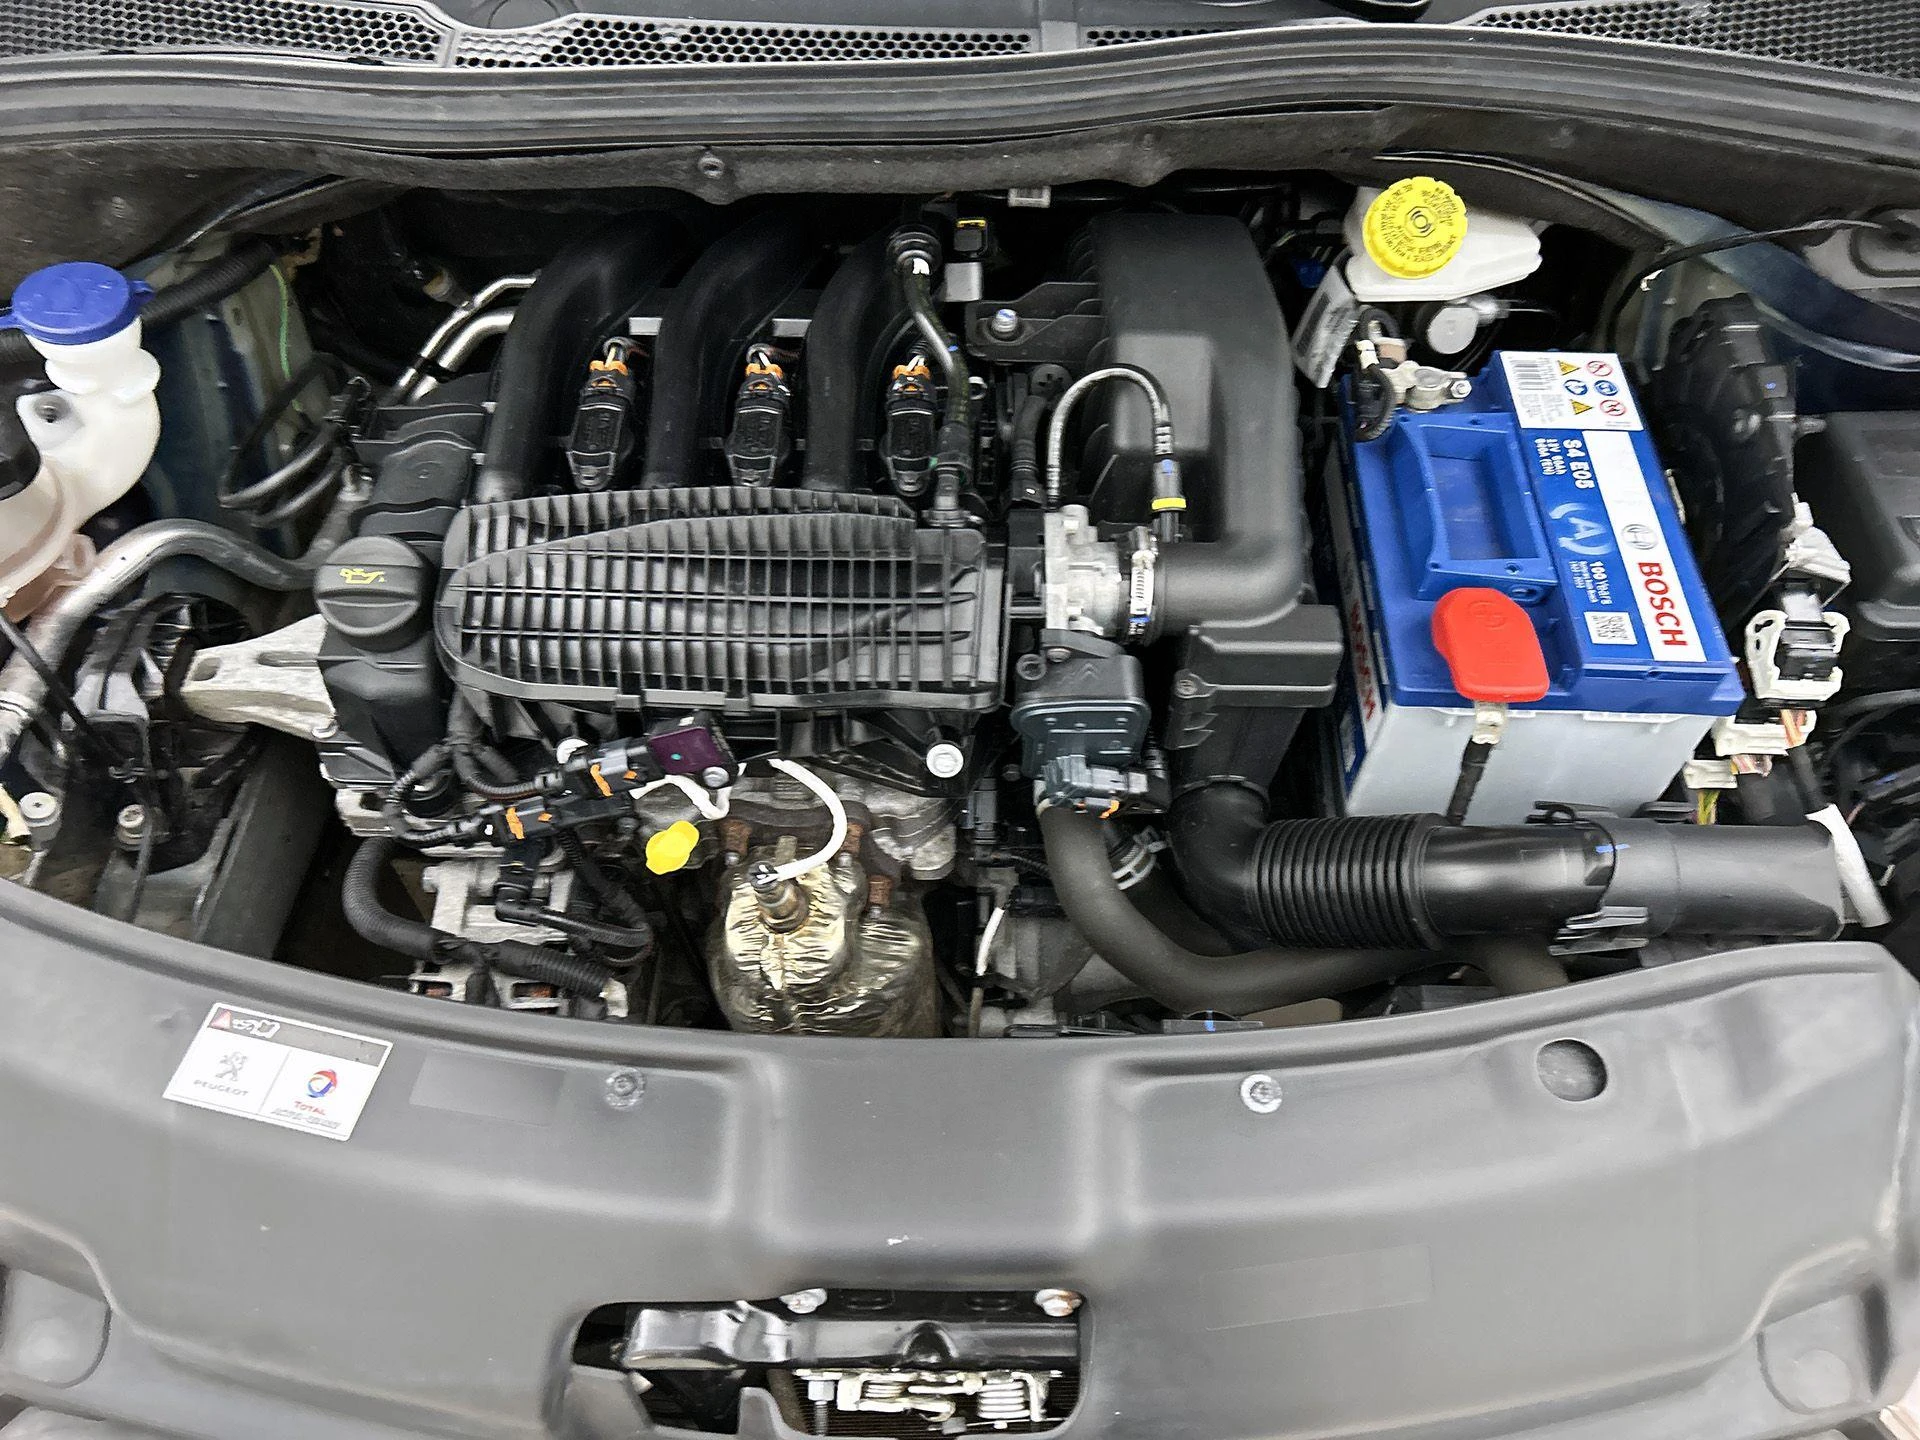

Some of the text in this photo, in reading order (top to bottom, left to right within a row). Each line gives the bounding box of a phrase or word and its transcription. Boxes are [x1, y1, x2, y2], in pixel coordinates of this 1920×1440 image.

[1562, 439, 1595, 489] S4 E05
[1590, 560, 1608, 580] 100
[1595, 580, 1613, 605] Years
[1638, 562, 1688, 646] BOSCH
[193, 1079, 249, 1097] PEUGEOT
[294, 1100, 327, 1116] TOTAL
